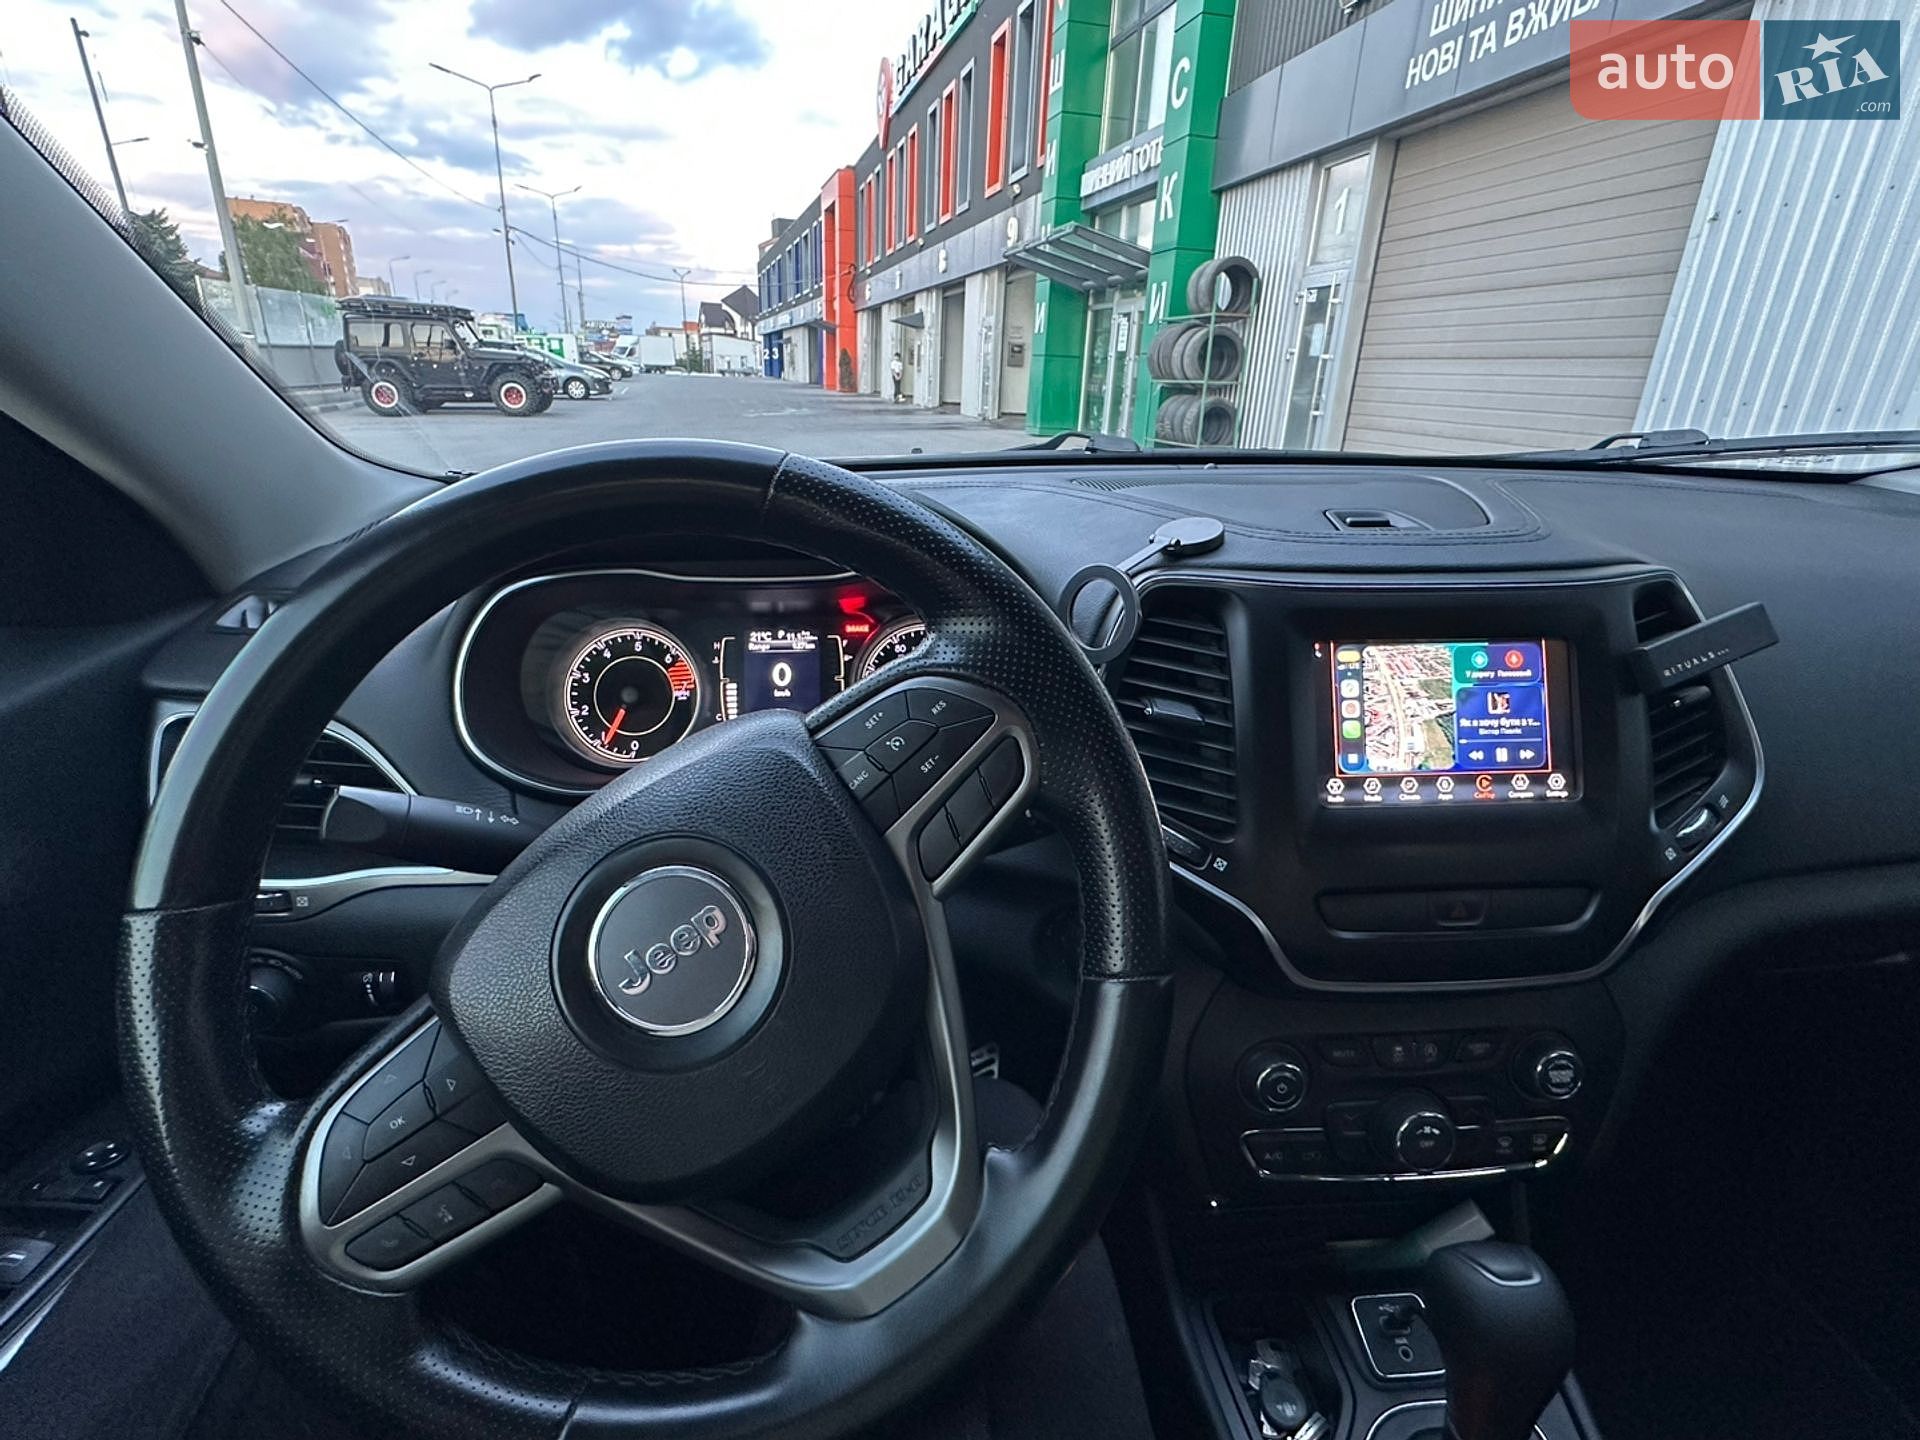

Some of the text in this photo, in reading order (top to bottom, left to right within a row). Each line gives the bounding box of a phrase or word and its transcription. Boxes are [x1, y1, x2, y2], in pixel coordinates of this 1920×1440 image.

[894, 0, 970, 97] GARAG
[1405, 0, 1600, 89] НОВІ ТА ВЖИВ
[1334, 187, 1351, 235] 1
[1007, 216, 1019, 247] 9
[634, 641, 643, 652] 5
[894, 644, 907, 653] 80
[603, 650, 612, 659] 4
[664, 654, 673, 664] 6
[582, 672, 591, 683] 3
[772, 662, 792, 687] 0
[581, 705, 590, 716] 2
[931, 700, 947, 715] RES
[630, 740, 640, 751] 0
[849, 769, 870, 790] CANC
[618, 904, 729, 996] Jeep
[389, 1115, 407, 1130] OK
